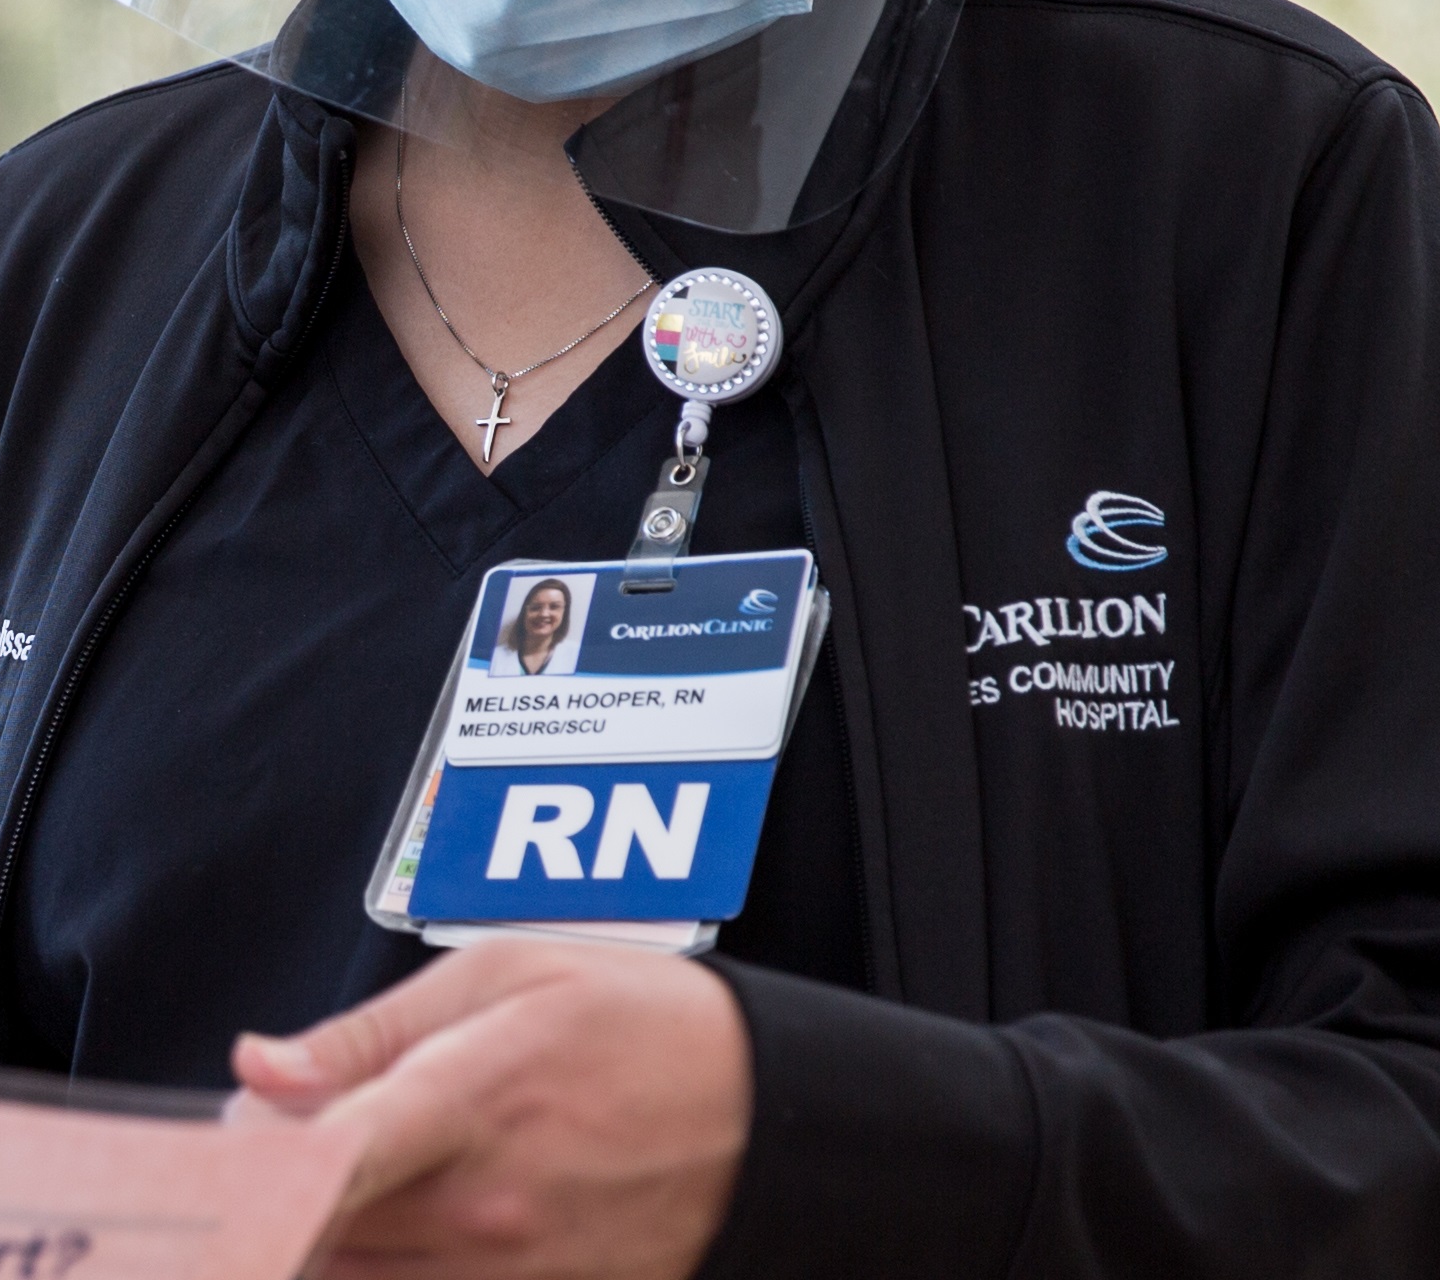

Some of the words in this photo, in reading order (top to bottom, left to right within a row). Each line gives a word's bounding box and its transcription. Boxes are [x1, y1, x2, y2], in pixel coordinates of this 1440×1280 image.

[688, 299, 746, 329] START
[1009, 660, 1175, 695] COMMUNITY
[465, 694, 561, 713] MELISSA
[567, 689, 666, 710] HOOPER,
[674, 688, 706, 705] RN
[1054, 696, 1181, 731] HOSPITAL
[458, 718, 608, 738] MED/SURG/SCU
[486, 782, 711, 880] RN
